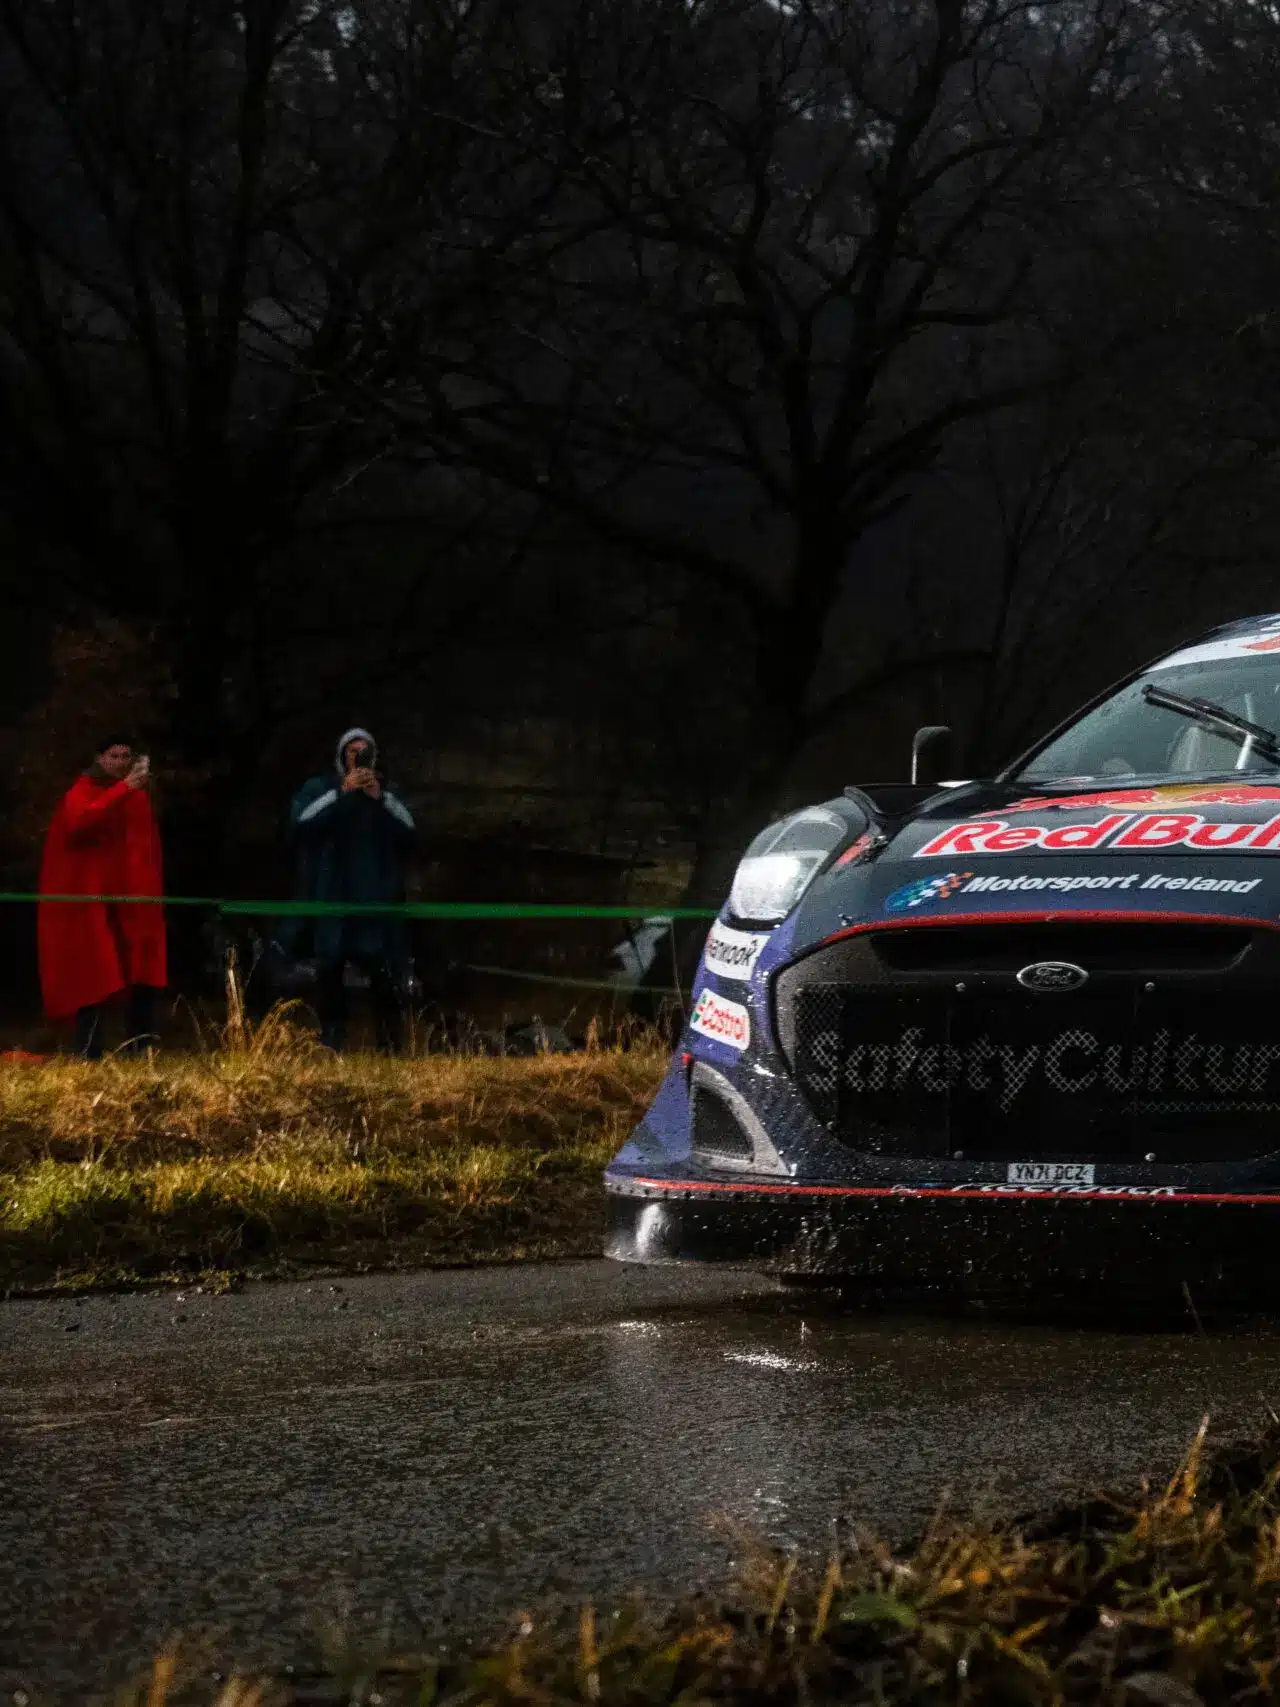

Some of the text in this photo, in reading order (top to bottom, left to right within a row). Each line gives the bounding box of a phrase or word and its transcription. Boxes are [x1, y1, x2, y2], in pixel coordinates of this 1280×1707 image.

[914, 814, 1128, 858] Red
[962, 872, 1262, 894] Motorsport Ireland
[701, 999, 748, 1041] Castrol
